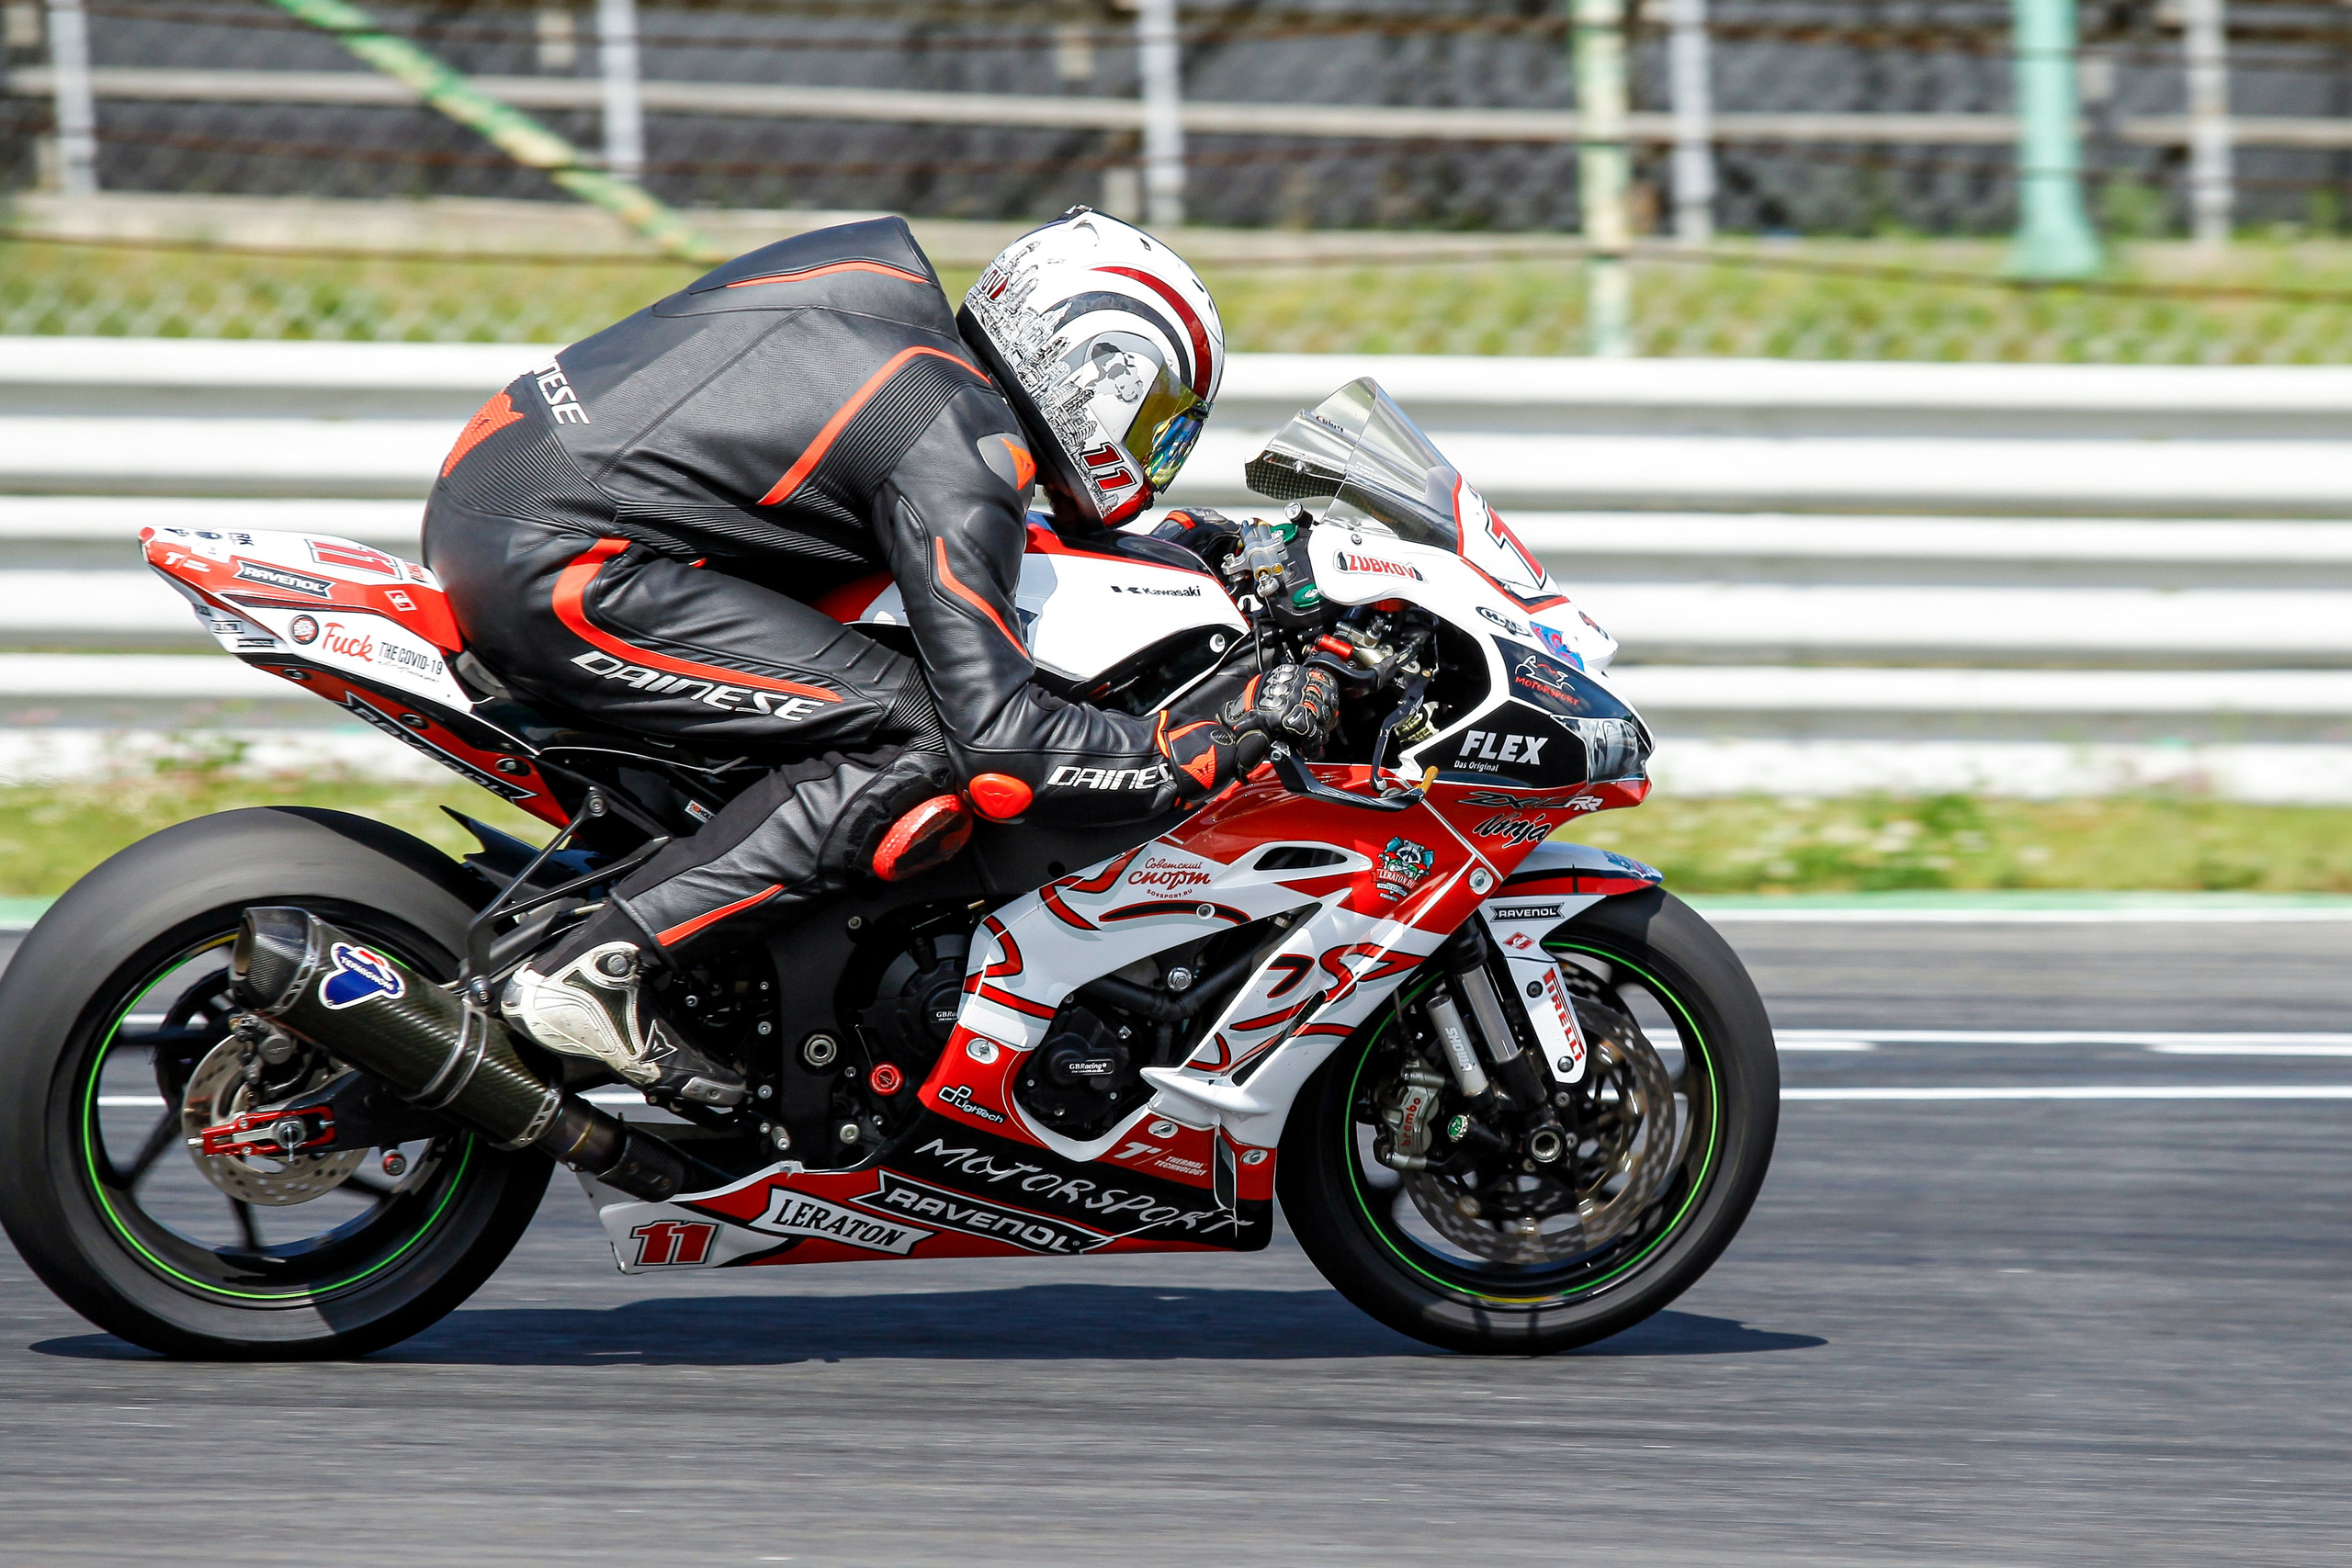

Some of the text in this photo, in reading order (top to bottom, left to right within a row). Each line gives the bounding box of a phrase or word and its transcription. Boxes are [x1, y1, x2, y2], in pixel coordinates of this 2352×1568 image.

[533, 358, 591, 425] NESE
[1080, 441, 1138, 492] 11
[243, 567, 324, 594] RAVENOL
[1346, 553, 1415, 579] ZUBKOV
[1142, 585, 1201, 597] Kawasaki
[322, 622, 375, 662] Fuck
[379, 641, 399, 660] THE
[398, 649, 443, 675] COVID-19
[570, 650, 825, 722] DAINESE
[1515, 675, 1579, 706] MOTORSPORT
[1459, 729, 1549, 765] FLEX
[1046, 762, 1174, 790] DAINES
[1453, 761, 1499, 773] Das Original
[1472, 813, 1552, 849] Ninja
[1145, 857, 1204, 870] Советский
[1379, 869, 1417, 889] LERATON.RU
[1146, 888, 1193, 899] SOVSPORT.RU
[1498, 907, 1558, 919] RAVENOL
[1542, 967, 1585, 1063] PIRELLI
[1069, 1062, 1103, 1072] GBRacing
[1400, 1097, 1421, 1147] brembo
[1153, 1160, 1207, 1177] TECHNOLOGY
[1164, 1156, 1204, 1169] THERMAL
[913, 1138, 1255, 1234] MOTORSPORT
[781, 1198, 908, 1247] LERATON
[884, 1187, 1072, 1254] RAVENOL
[629, 1219, 720, 1267] 11
